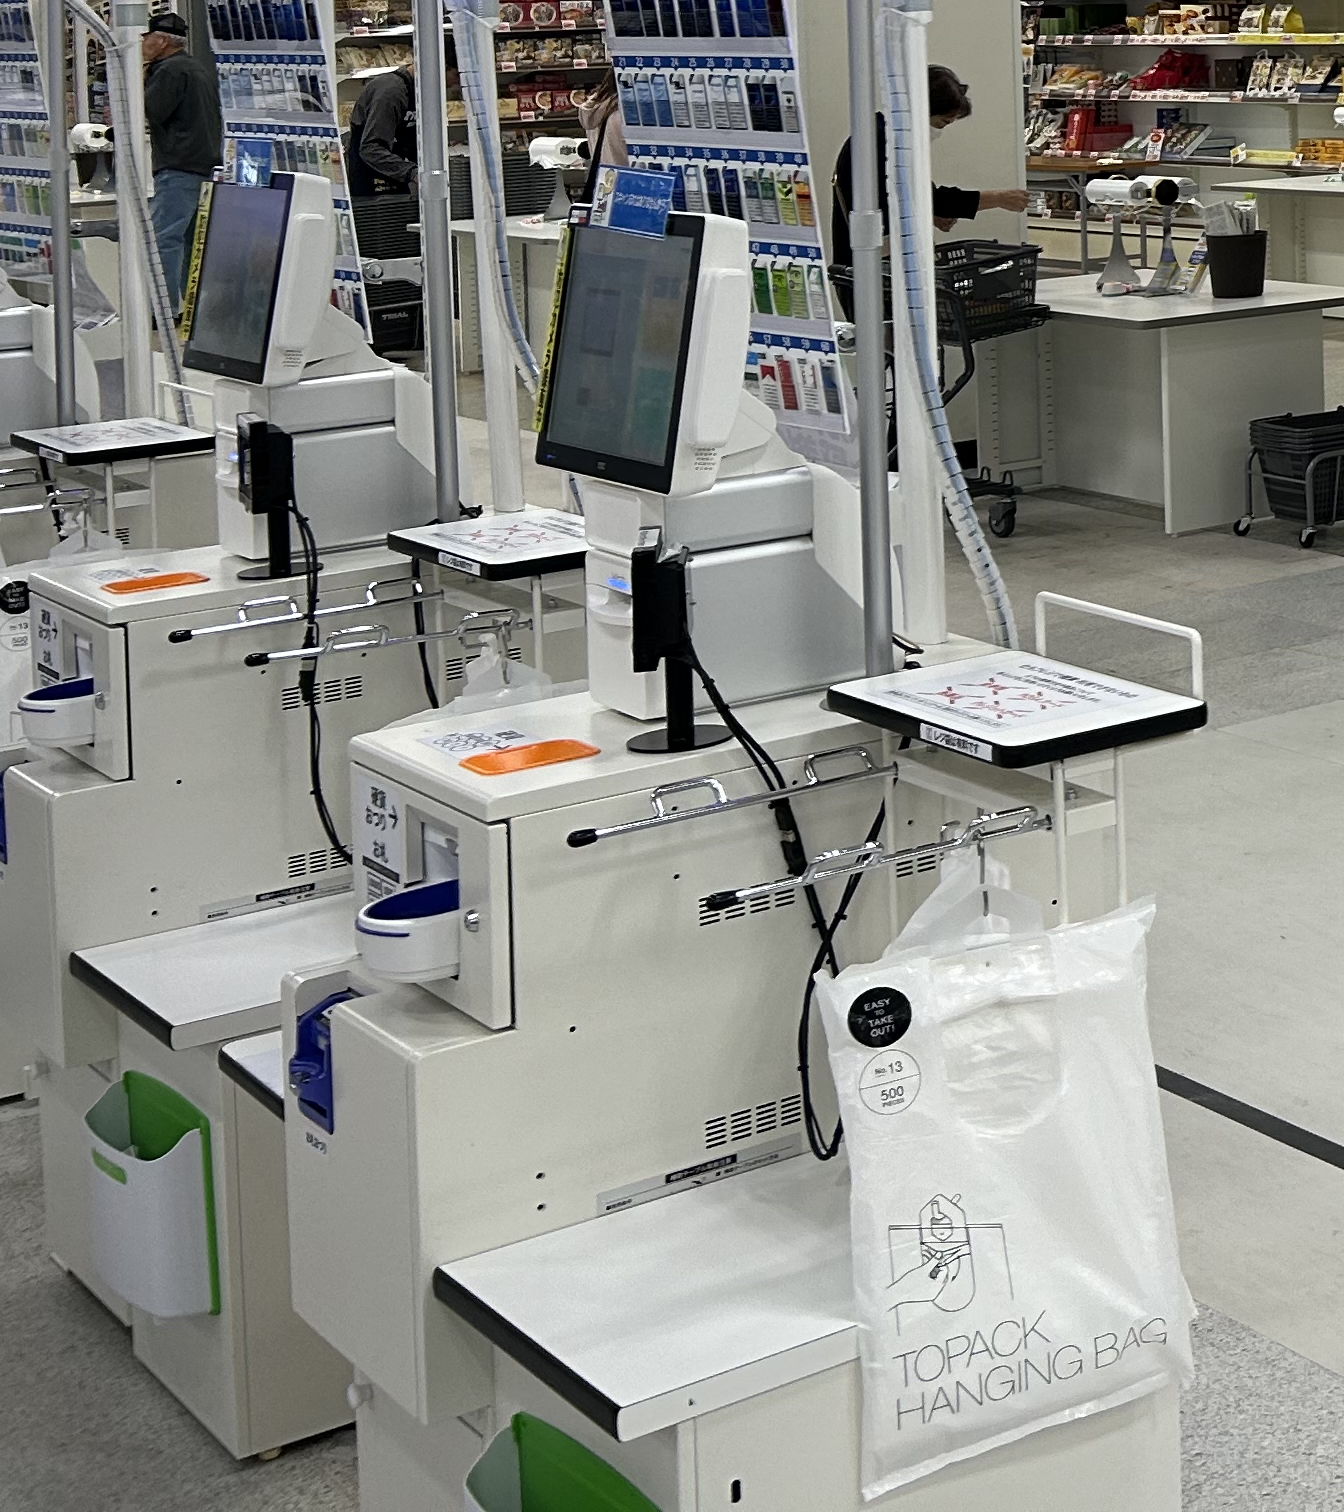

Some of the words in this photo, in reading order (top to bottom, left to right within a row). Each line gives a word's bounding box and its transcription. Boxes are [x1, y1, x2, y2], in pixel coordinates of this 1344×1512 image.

[366, 805, 386, 831] おつり
[864, 997, 890, 1011] EASY
[874, 1008, 885, 1016] TO
[868, 1014, 894, 1028] TAKE
[870, 1024, 895, 1037] OUT!
[881, 1085, 904, 1101] 500
[892, 1308, 1051, 1388] TOPACK
[895, 1343, 1084, 1431] HANGING
[1095, 1317, 1168, 1371] BAG
